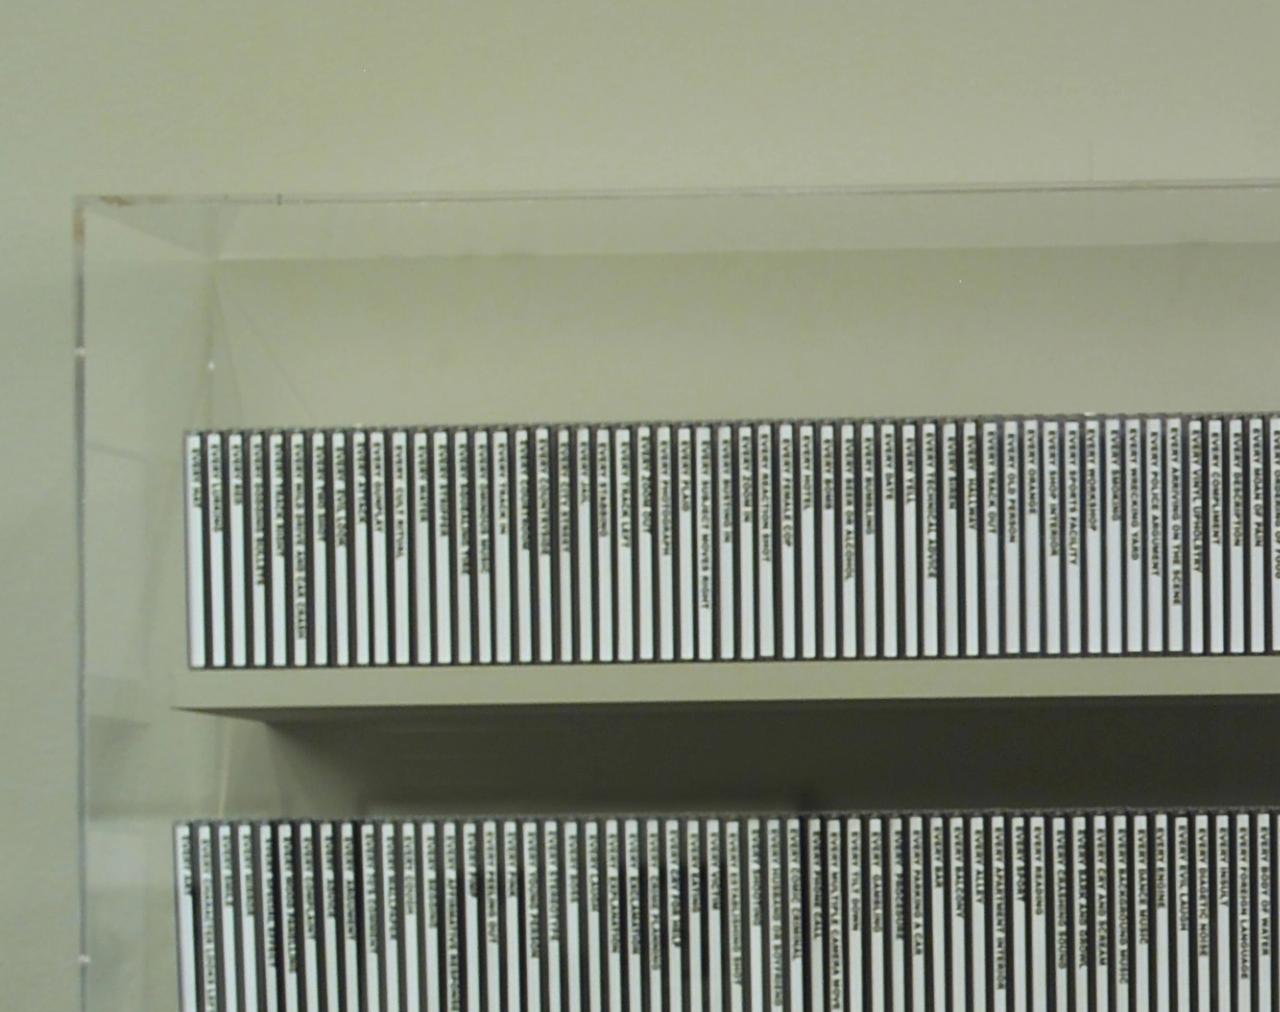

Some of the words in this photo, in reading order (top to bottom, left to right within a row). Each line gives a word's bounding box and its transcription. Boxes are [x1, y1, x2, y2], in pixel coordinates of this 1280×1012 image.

[372, 441, 382, 477] EVERY
[620, 441, 630, 476] EVERY
[1150, 430, 1159, 467] EVERY
[1150, 470, 1159, 511] POLICE
[1150, 514, 1160, 576] ARGUMENT
[932, 827, 942, 862] EVERY
